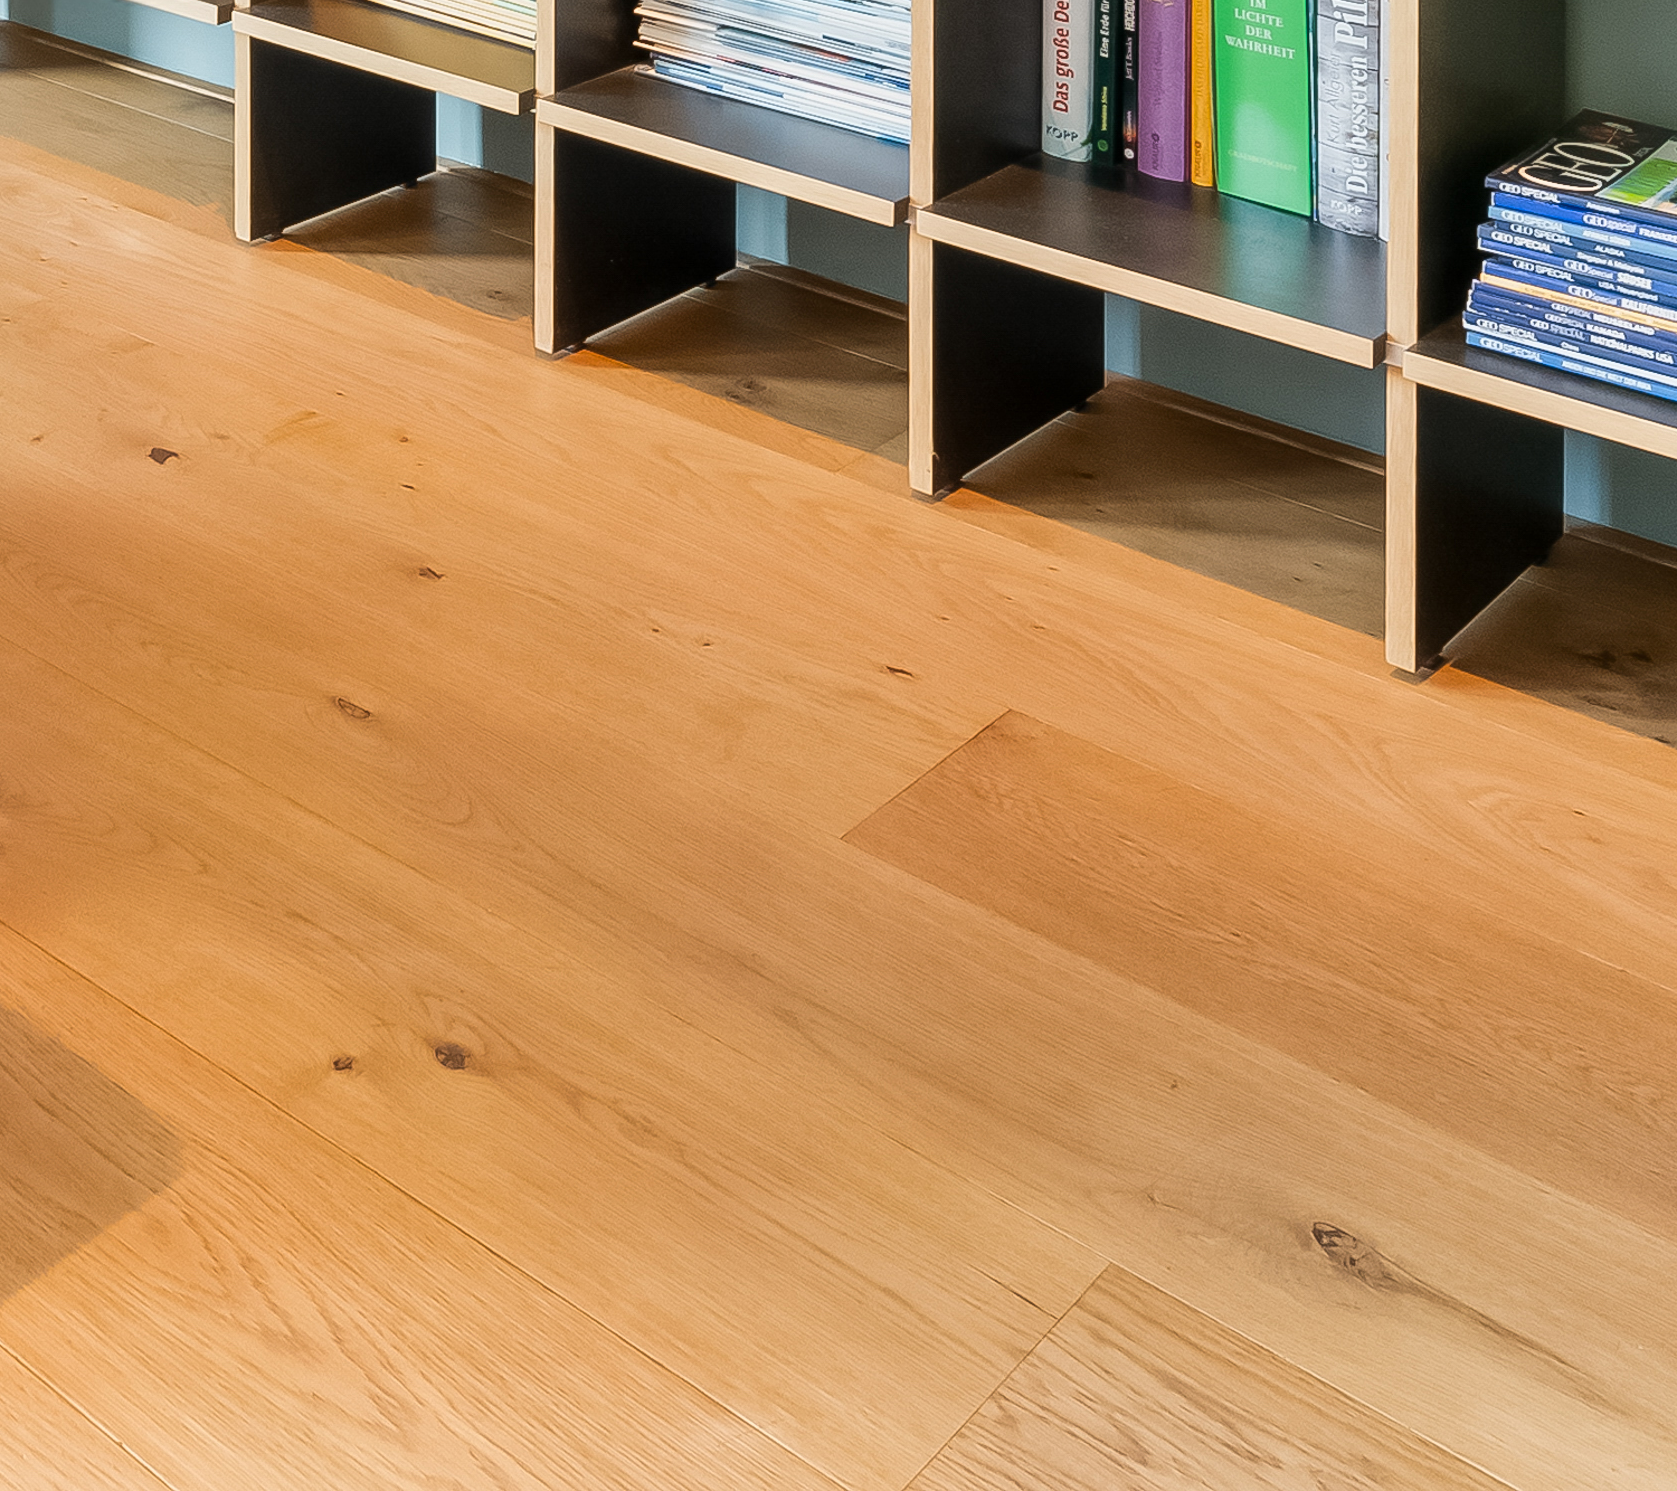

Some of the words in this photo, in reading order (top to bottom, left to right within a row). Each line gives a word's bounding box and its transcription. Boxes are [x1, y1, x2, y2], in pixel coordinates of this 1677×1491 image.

[1235, 9, 1284, 27] LICHTE
[1245, 25, 1272, 40] DER
[1053, 24, 1074, 78] große
[1225, 35, 1295, 59] WAHRHEIT
[1053, 81, 1068, 114] Das
[1346, 58, 1368, 145] besseren
[1346, 151, 1368, 194] Die
